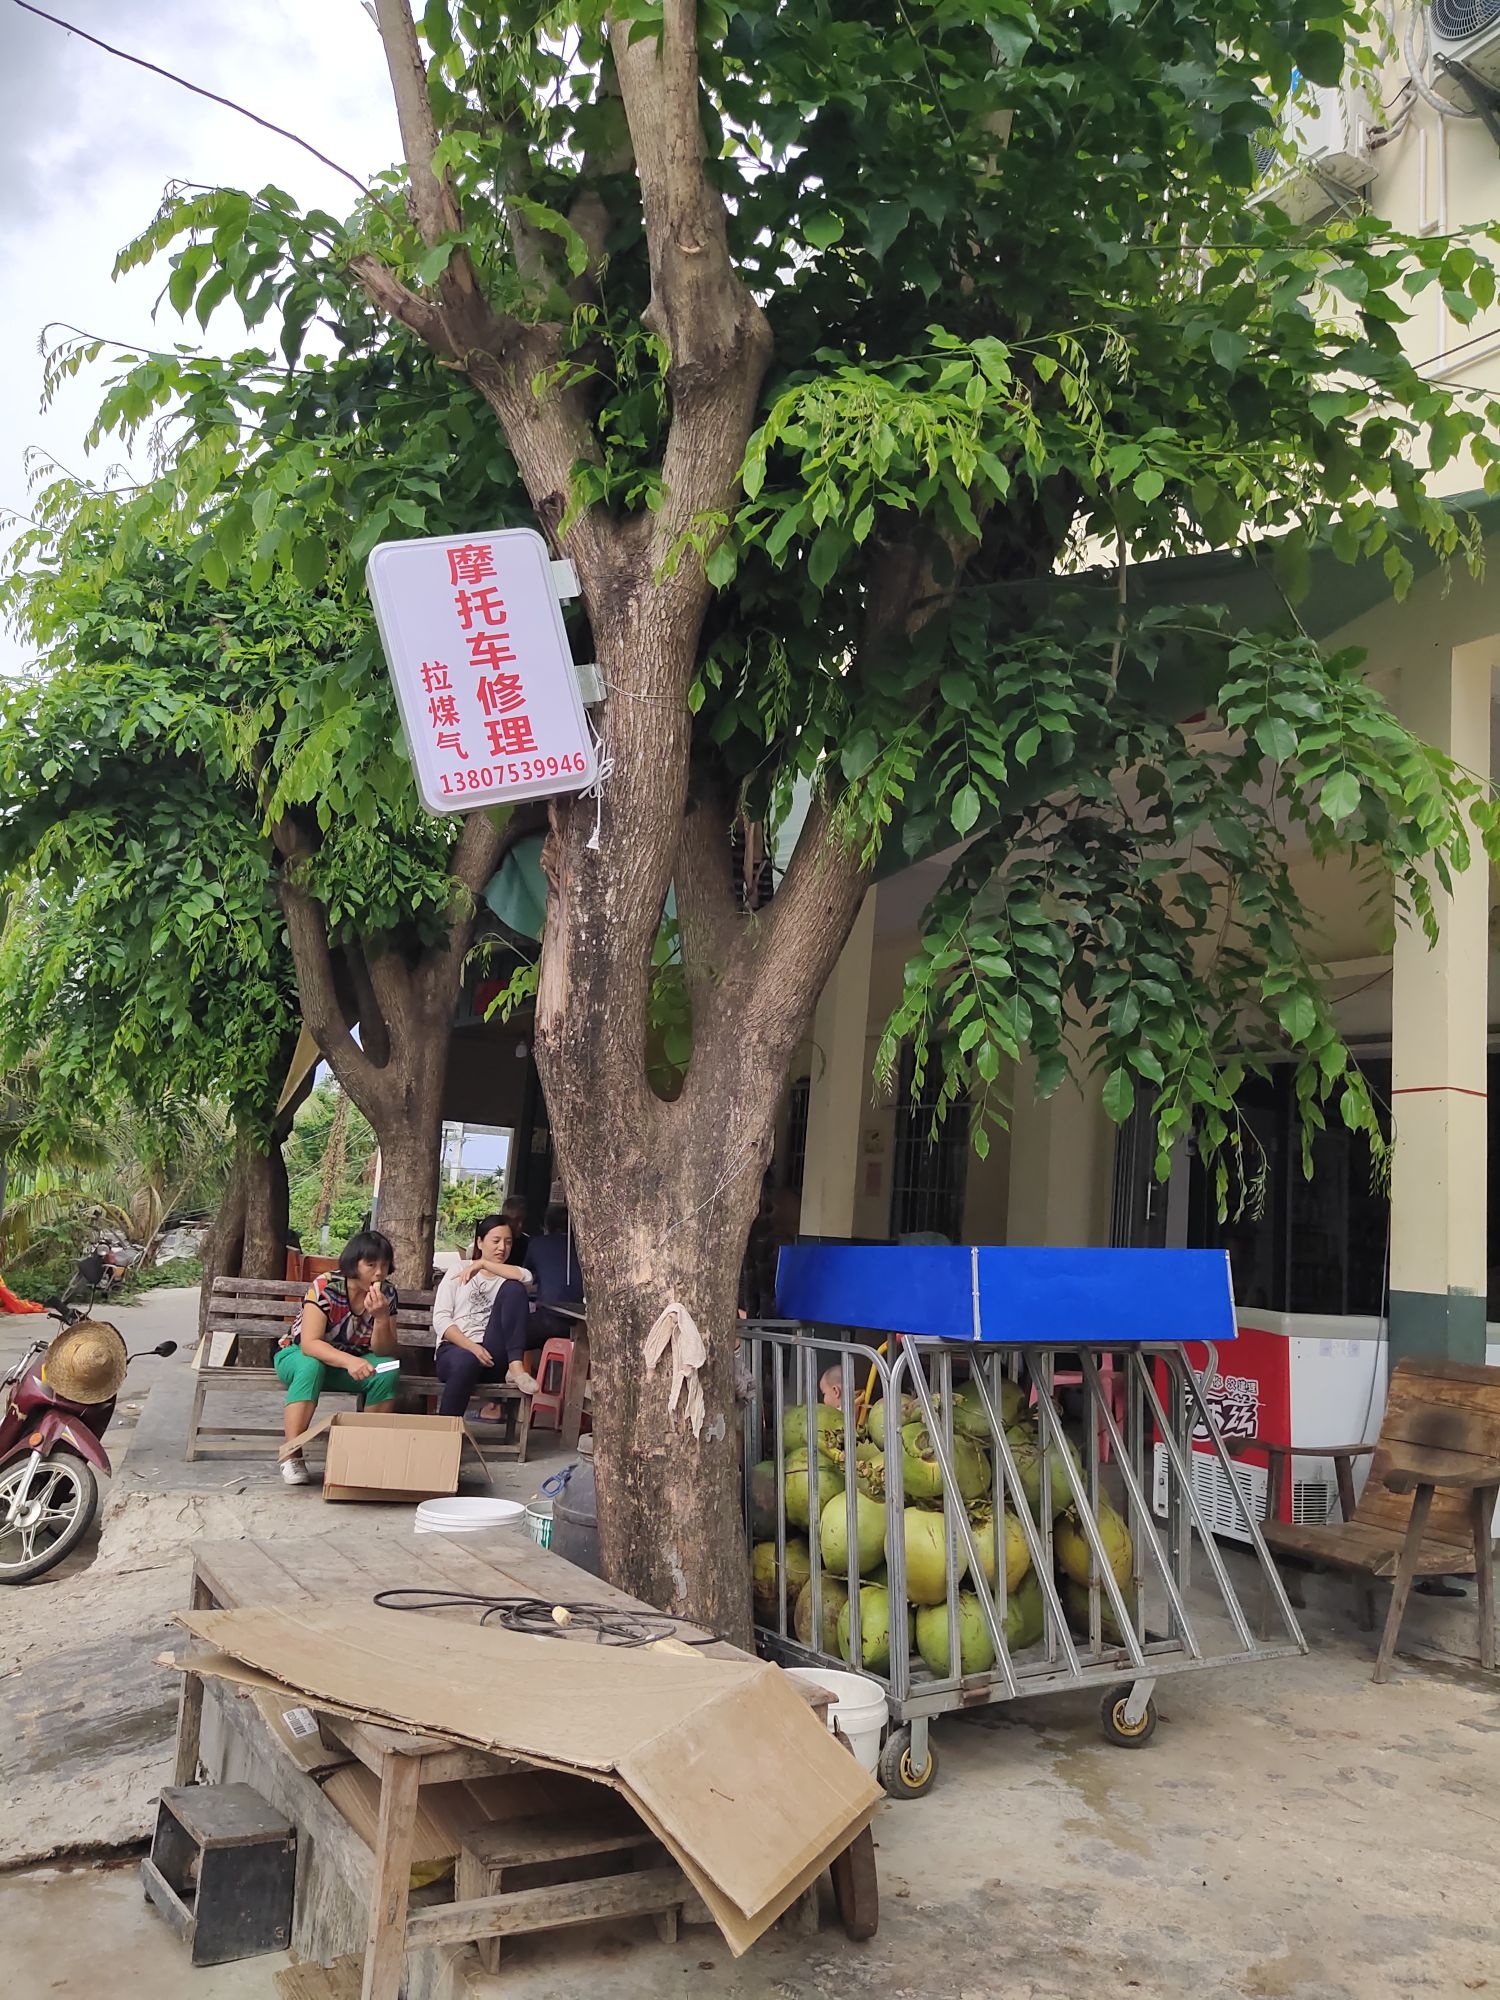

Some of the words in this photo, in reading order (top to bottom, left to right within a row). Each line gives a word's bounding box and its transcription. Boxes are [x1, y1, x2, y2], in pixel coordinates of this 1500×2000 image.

[446, 544, 538, 757] 摩托车修理
[420, 660, 469, 760] 拉煤气
[439, 752, 586, 794] 13807539946
